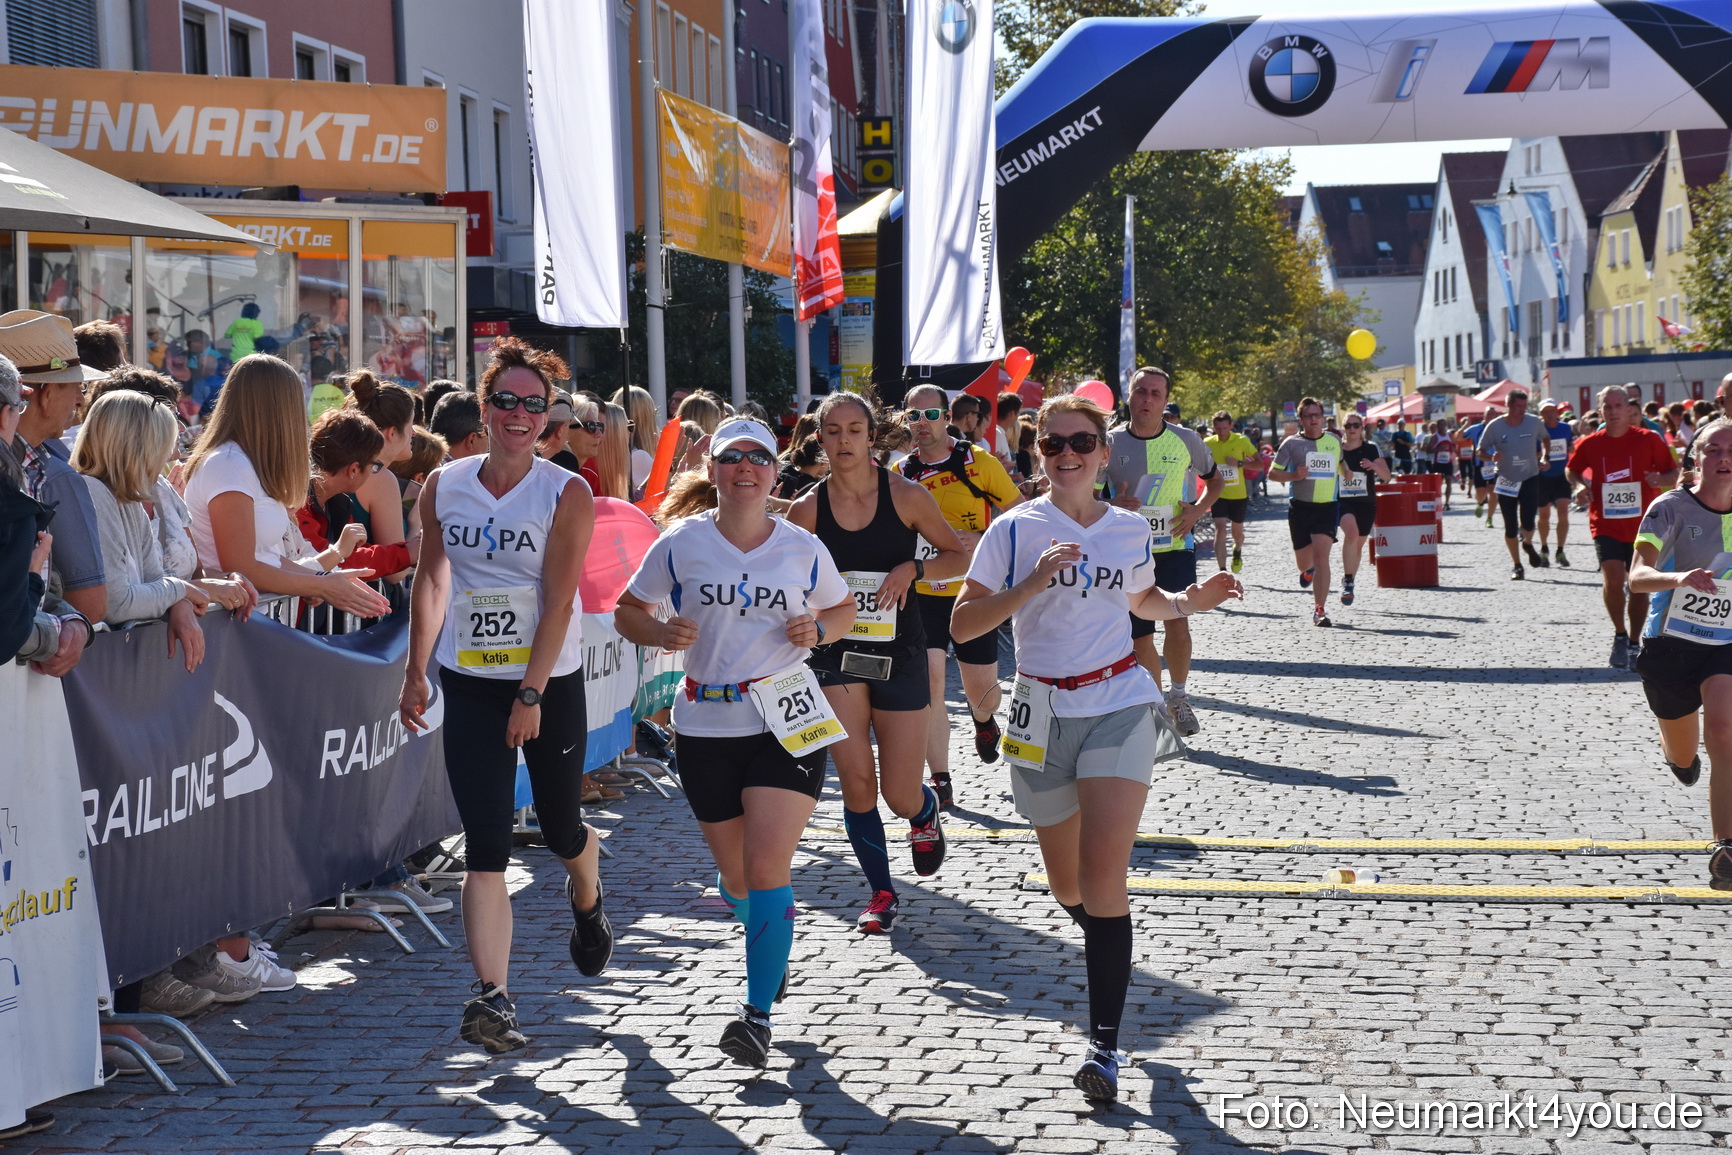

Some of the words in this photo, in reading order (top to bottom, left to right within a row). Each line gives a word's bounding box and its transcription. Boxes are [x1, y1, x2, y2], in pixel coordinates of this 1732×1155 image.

[1257, 36, 1328, 60] BMW
[1310, 459, 1330, 468] 3091
[1608, 492, 1636, 504] 2436
[1146, 518, 1165, 531] 91
[447, 517, 537, 560] SUSPA
[472, 595, 510, 605] BOCK
[700, 573, 788, 616] SUSPA
[854, 591, 879, 612] 35
[1682, 594, 1732, 618] 2239
[470, 611, 517, 637] 252
[850, 624, 868, 633] lisa
[1690, 625, 1714, 638] Laura
[482, 651, 509, 665] Katja
[774, 672, 805, 691] BOCK
[778, 687, 817, 724] 251
[1008, 698, 1031, 729] 50
[82, 752, 217, 847] RAIL.ONE
